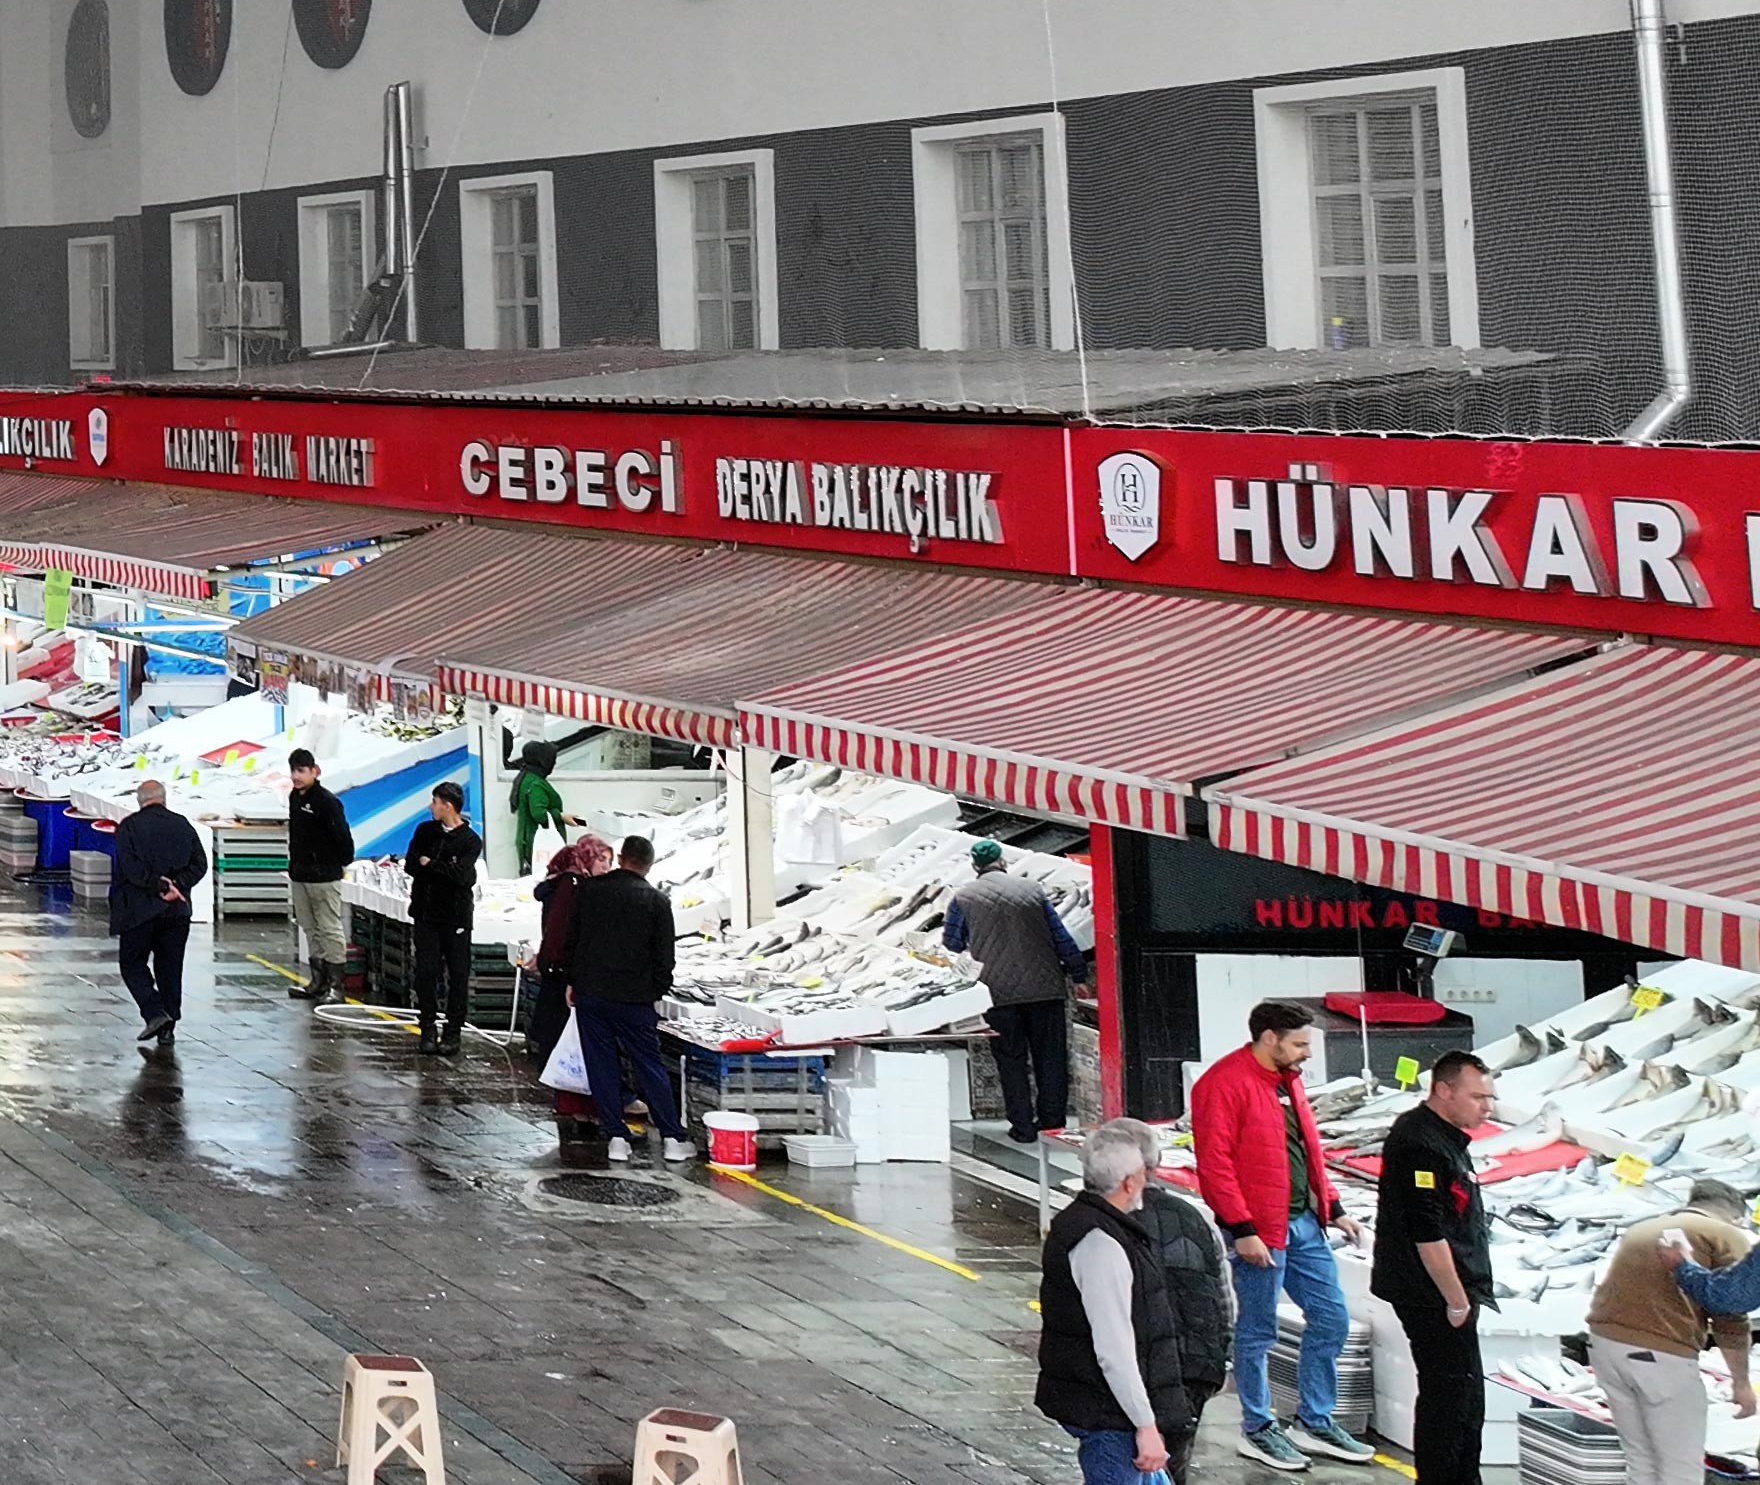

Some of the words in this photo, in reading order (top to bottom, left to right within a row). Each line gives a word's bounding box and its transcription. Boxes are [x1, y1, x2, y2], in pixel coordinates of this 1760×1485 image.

[252, 432, 298, 479] BALIK
[306, 435, 373, 487] MARKET
[460, 440, 678, 513] CEBECİ
[716, 457, 805, 525] DERYA
[812, 462, 998, 553] BALIKÇILIK
[1110, 512, 1154, 528] HÜNKAR
[1214, 462, 1708, 607] HÜNKAR
[1254, 894, 1441, 928] HÜNKAR
